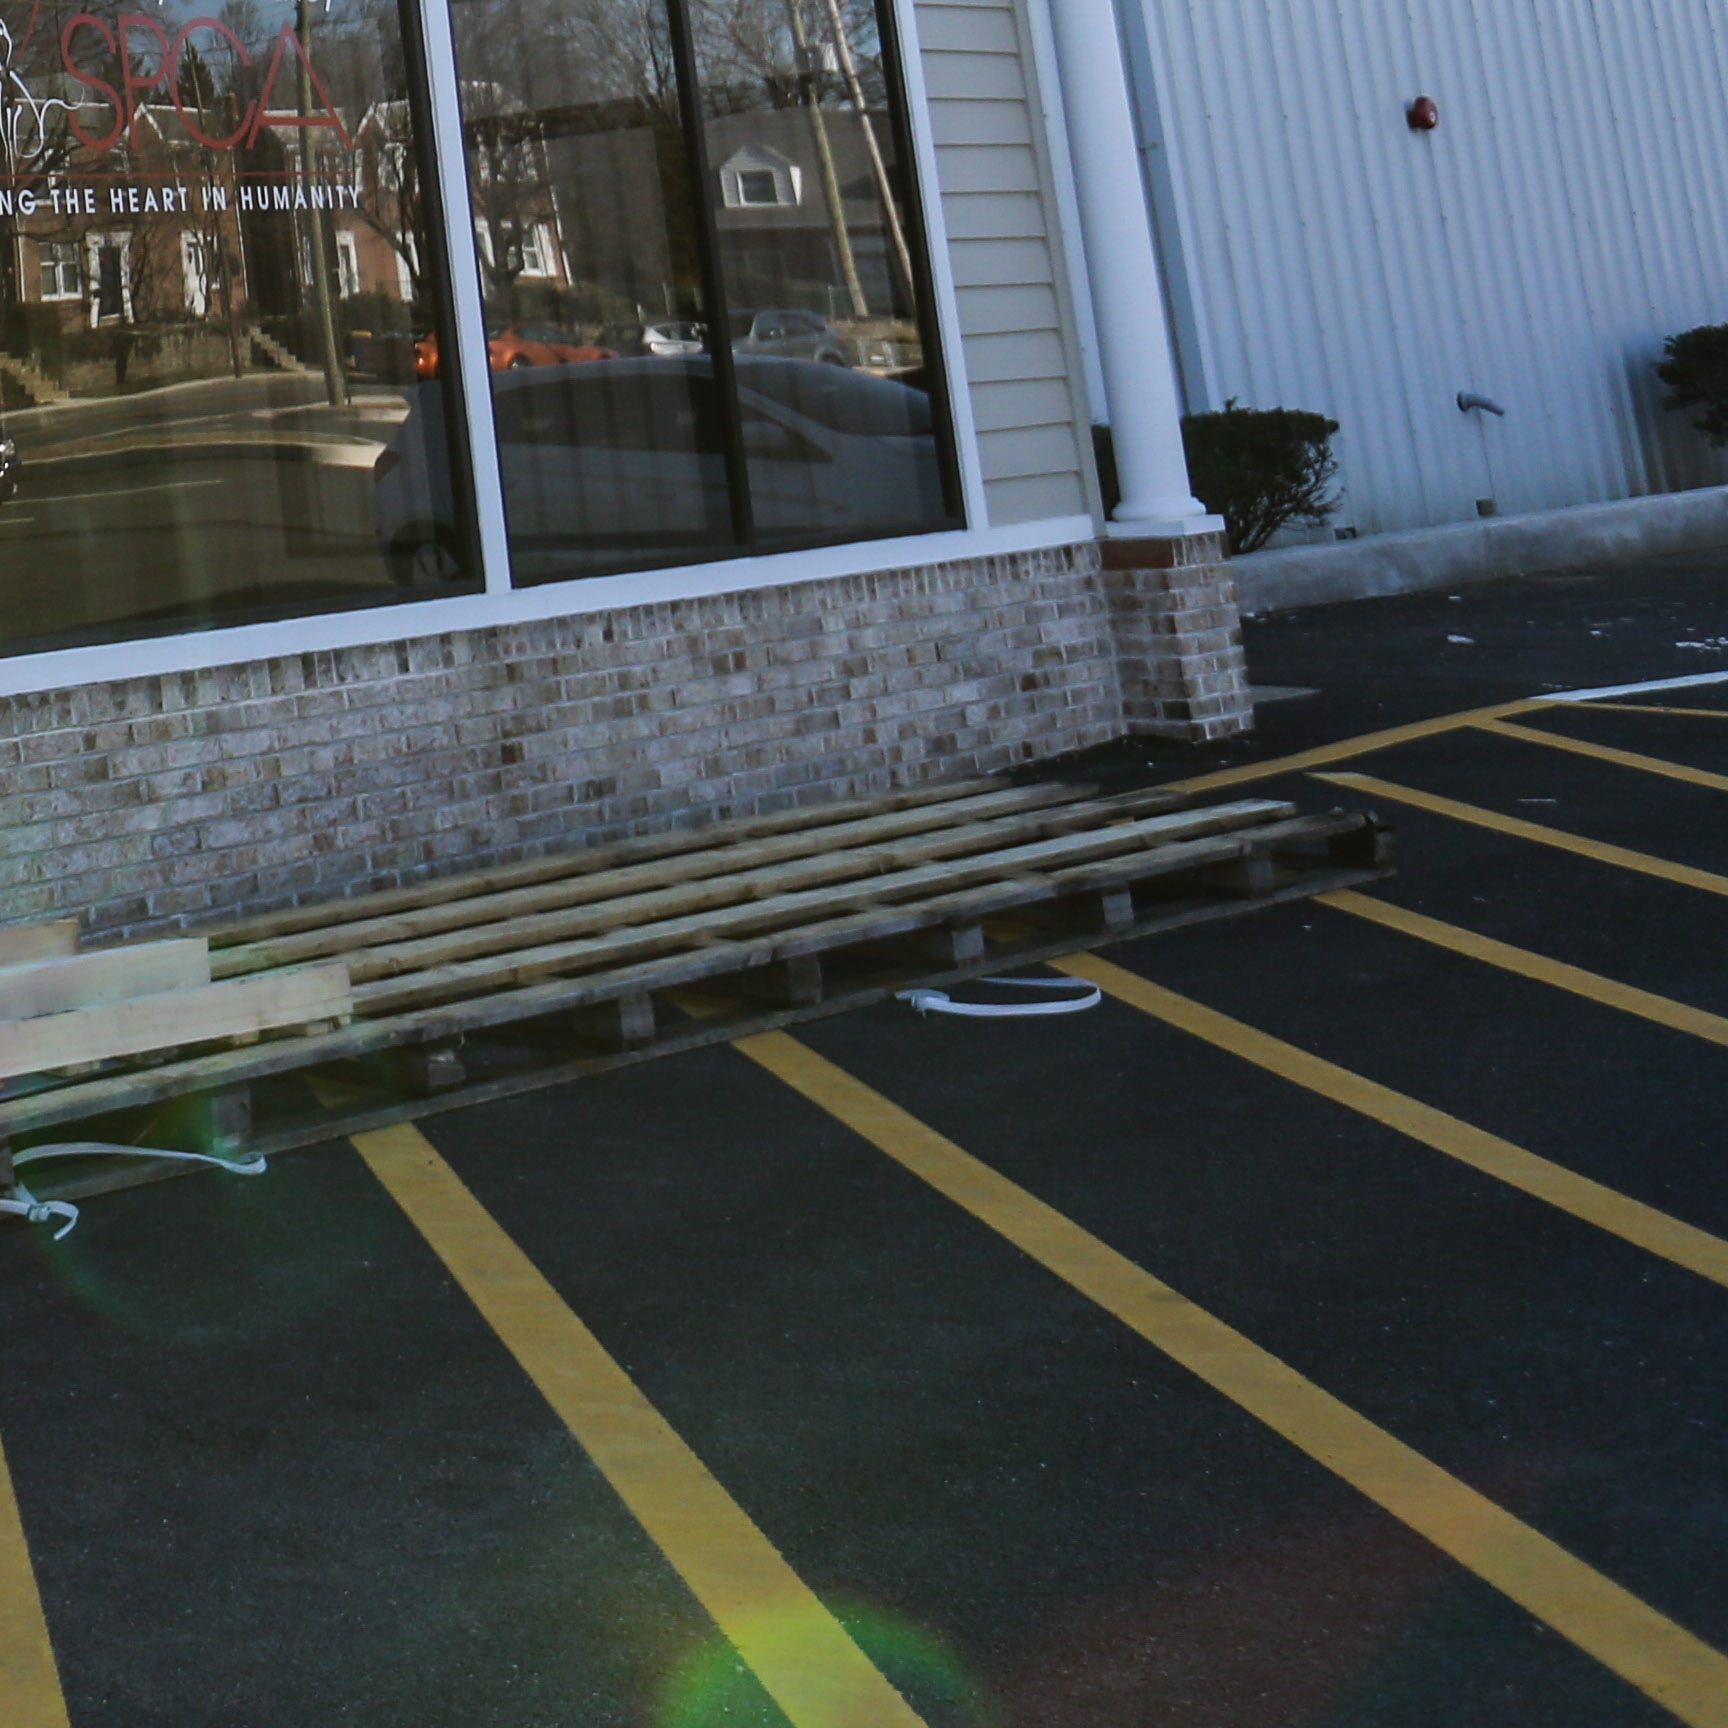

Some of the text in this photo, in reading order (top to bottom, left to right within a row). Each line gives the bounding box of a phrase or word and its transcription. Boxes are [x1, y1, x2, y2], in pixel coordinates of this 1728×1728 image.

[61, 13, 354, 150] SPCA
[50, 187, 96, 214] THE
[110, 186, 188, 213] HEART
[201, 185, 228, 212] IN
[240, 184, 360, 210] HUMANITY
